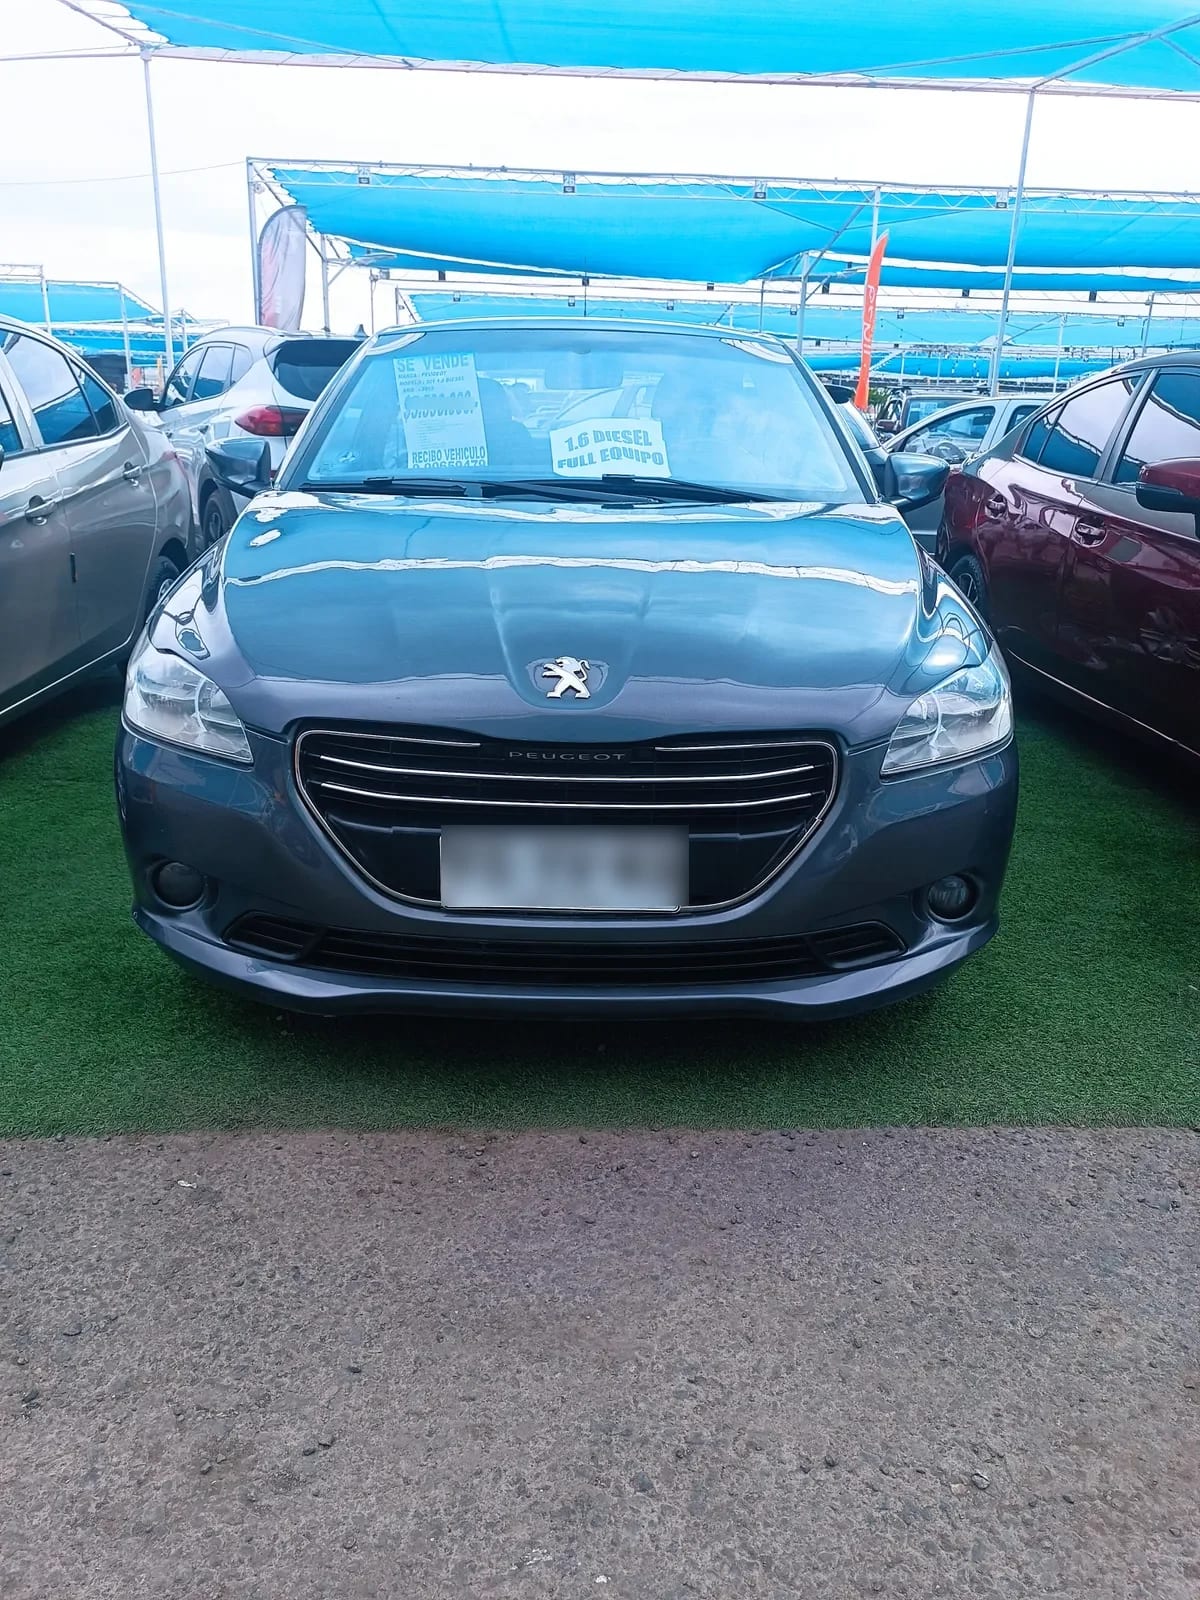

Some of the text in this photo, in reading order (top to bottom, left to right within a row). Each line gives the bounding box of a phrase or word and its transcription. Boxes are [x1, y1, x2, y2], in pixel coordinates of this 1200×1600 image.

[397, 354, 470, 372] SE VENDE
[565, 429, 653, 452] 1.6 DIESEL
[412, 446, 486, 464] RECIBO VEHICULO
[557, 446, 664, 469] FULL EQUIPO
[508, 751, 626, 761] PEUGEOT
